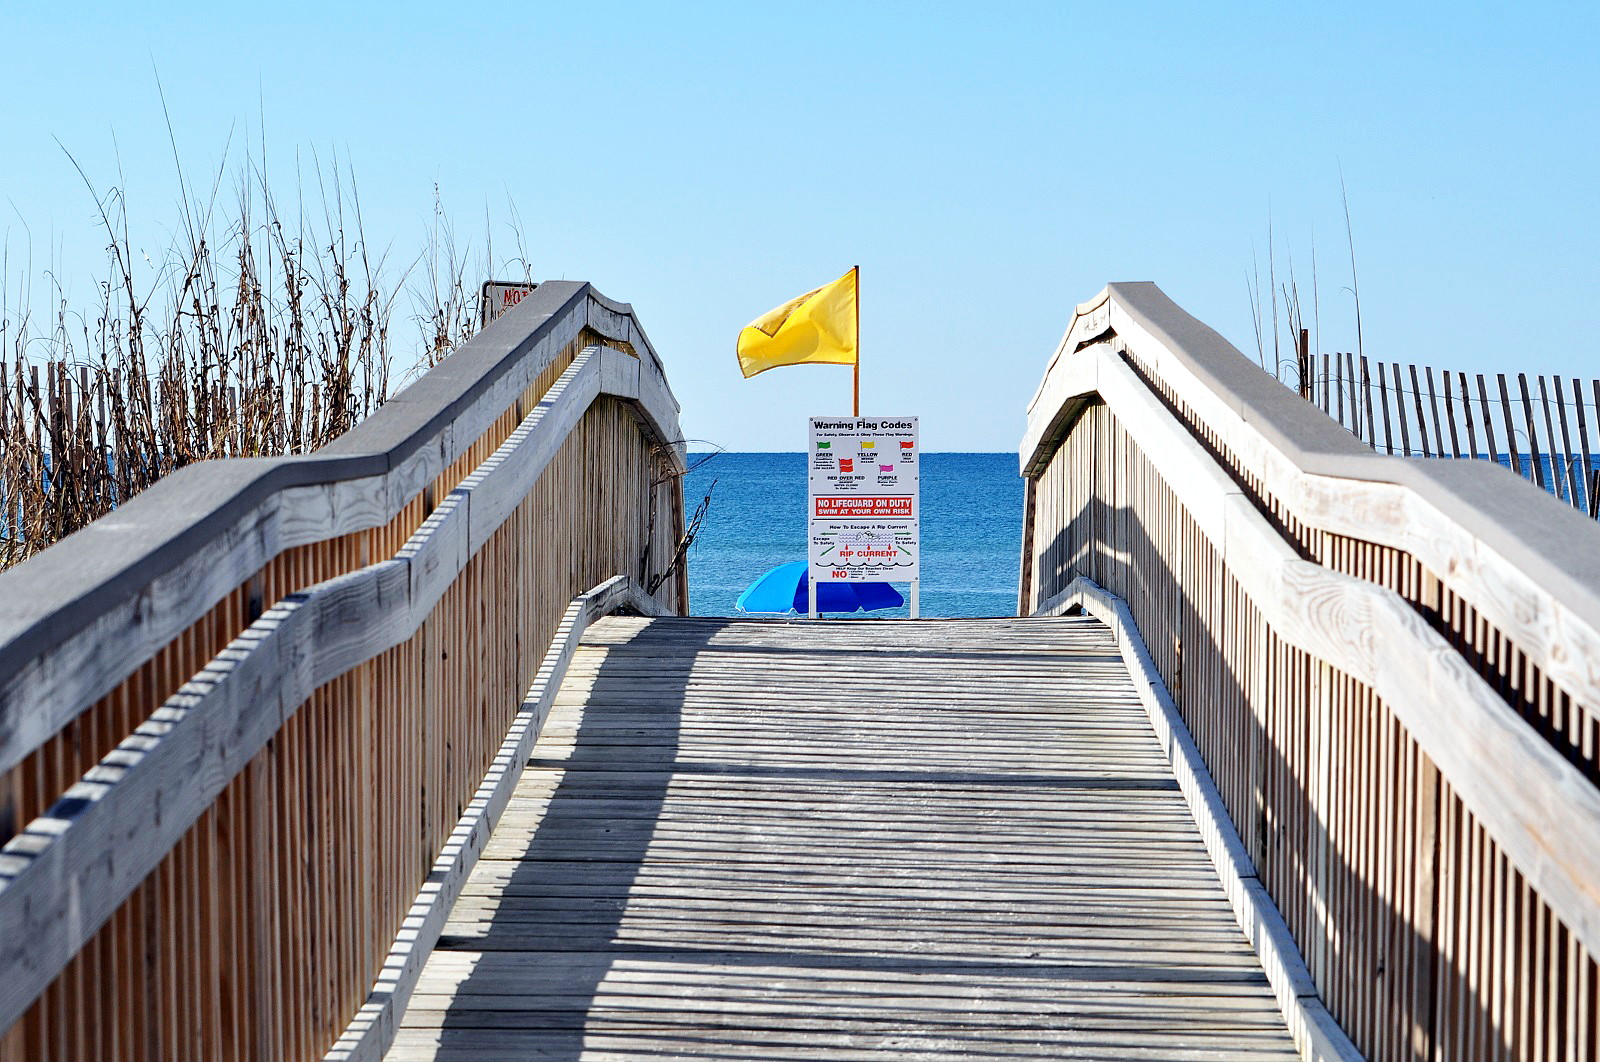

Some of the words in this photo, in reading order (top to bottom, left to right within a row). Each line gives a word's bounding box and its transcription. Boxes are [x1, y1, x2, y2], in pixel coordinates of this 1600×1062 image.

[814, 421, 854, 430] Warning
[856, 421, 878, 430] Flag
[880, 421, 912, 429] Codes
